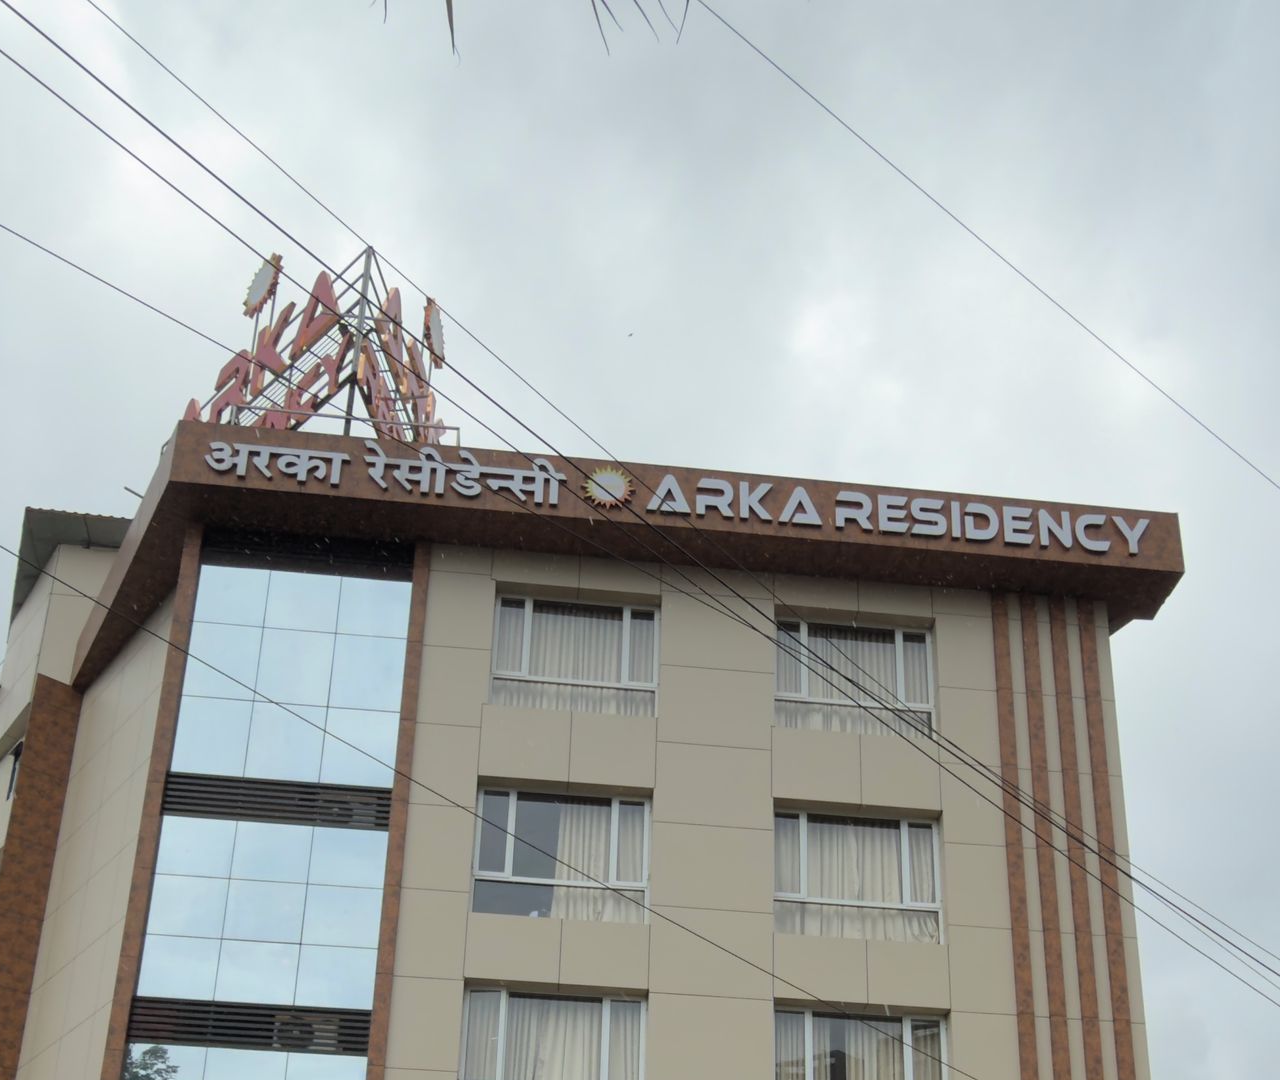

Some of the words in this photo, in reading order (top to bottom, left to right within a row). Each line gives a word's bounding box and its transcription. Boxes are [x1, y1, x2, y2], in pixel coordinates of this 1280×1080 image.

[204, 441, 351, 486] अरका
[363, 440, 567, 505] रेसीडेन्सी
[645, 473, 823, 526] ARKA
[834, 491, 1151, 555] RESIDENCY
